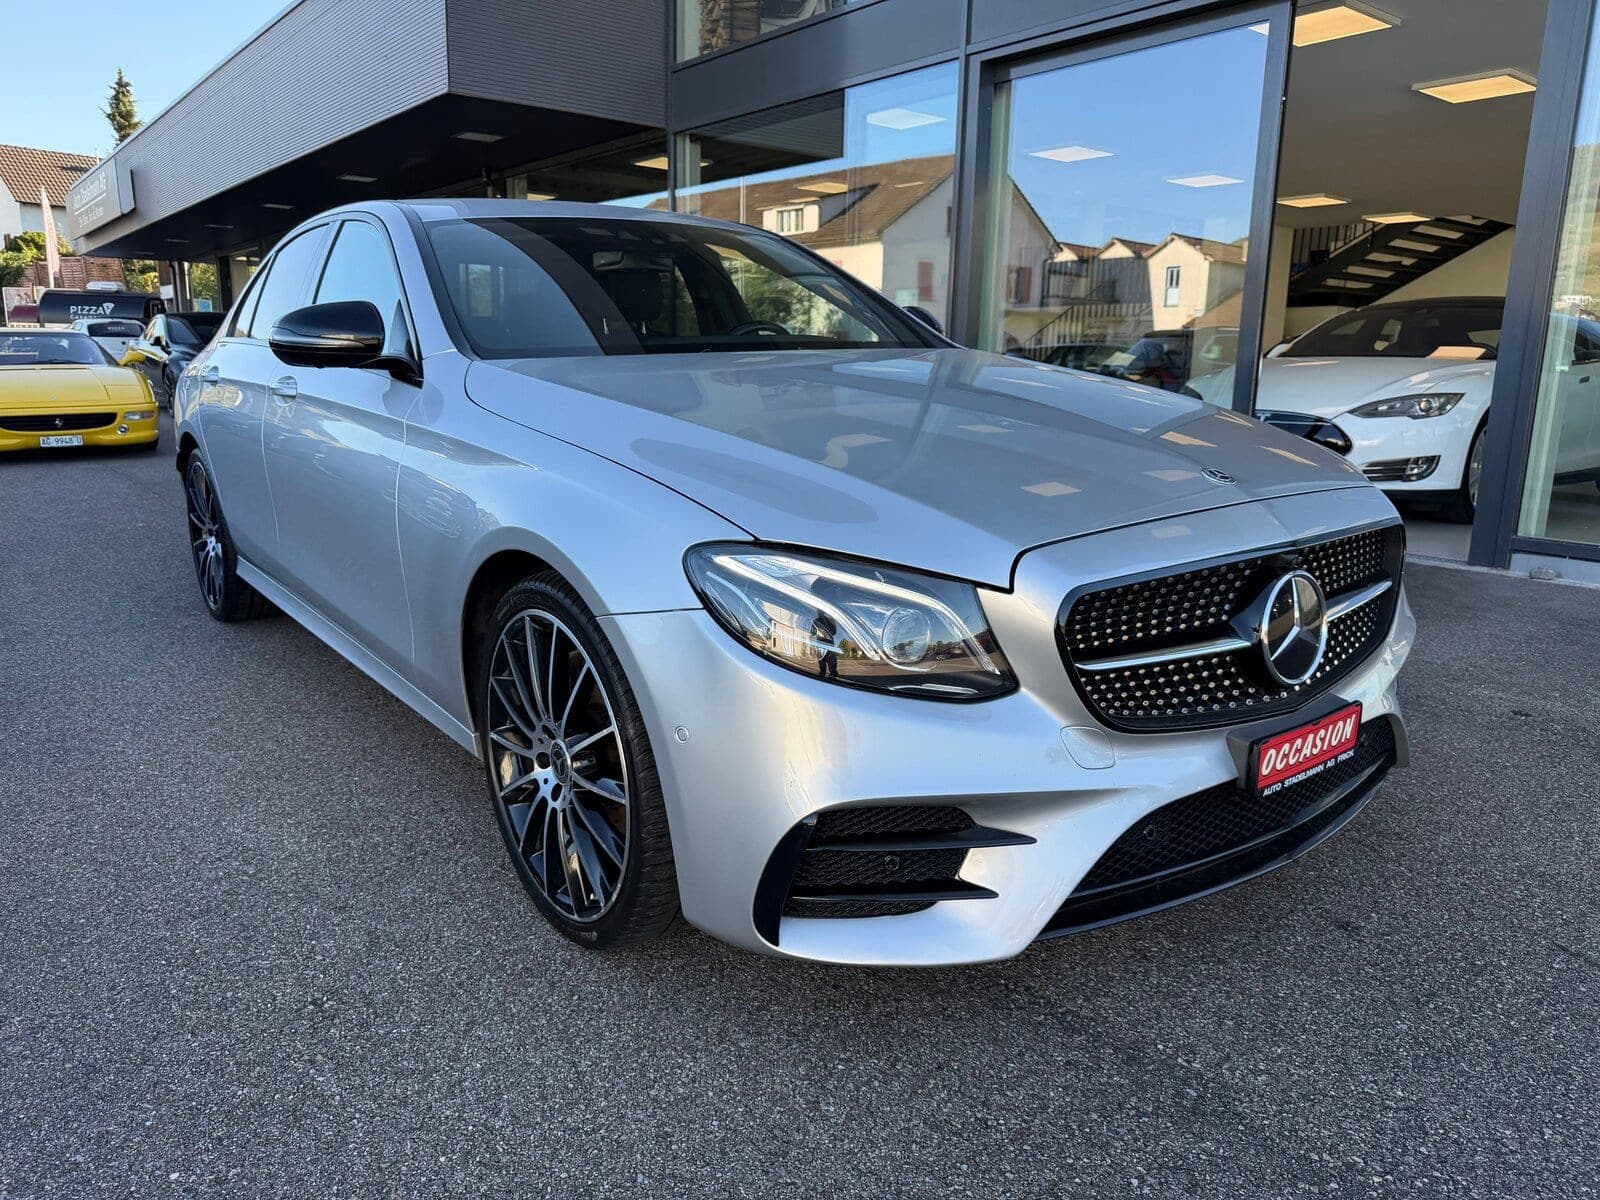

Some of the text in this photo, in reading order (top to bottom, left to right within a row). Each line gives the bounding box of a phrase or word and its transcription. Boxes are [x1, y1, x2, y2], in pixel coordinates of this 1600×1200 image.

[70, 305, 104, 315] PIZZA
[41, 438, 51, 446] AG
[1262, 714, 1355, 776] OCCASION
[1263, 782, 1281, 797] AUTO
[1283, 763, 1324, 787] STADELMANN
